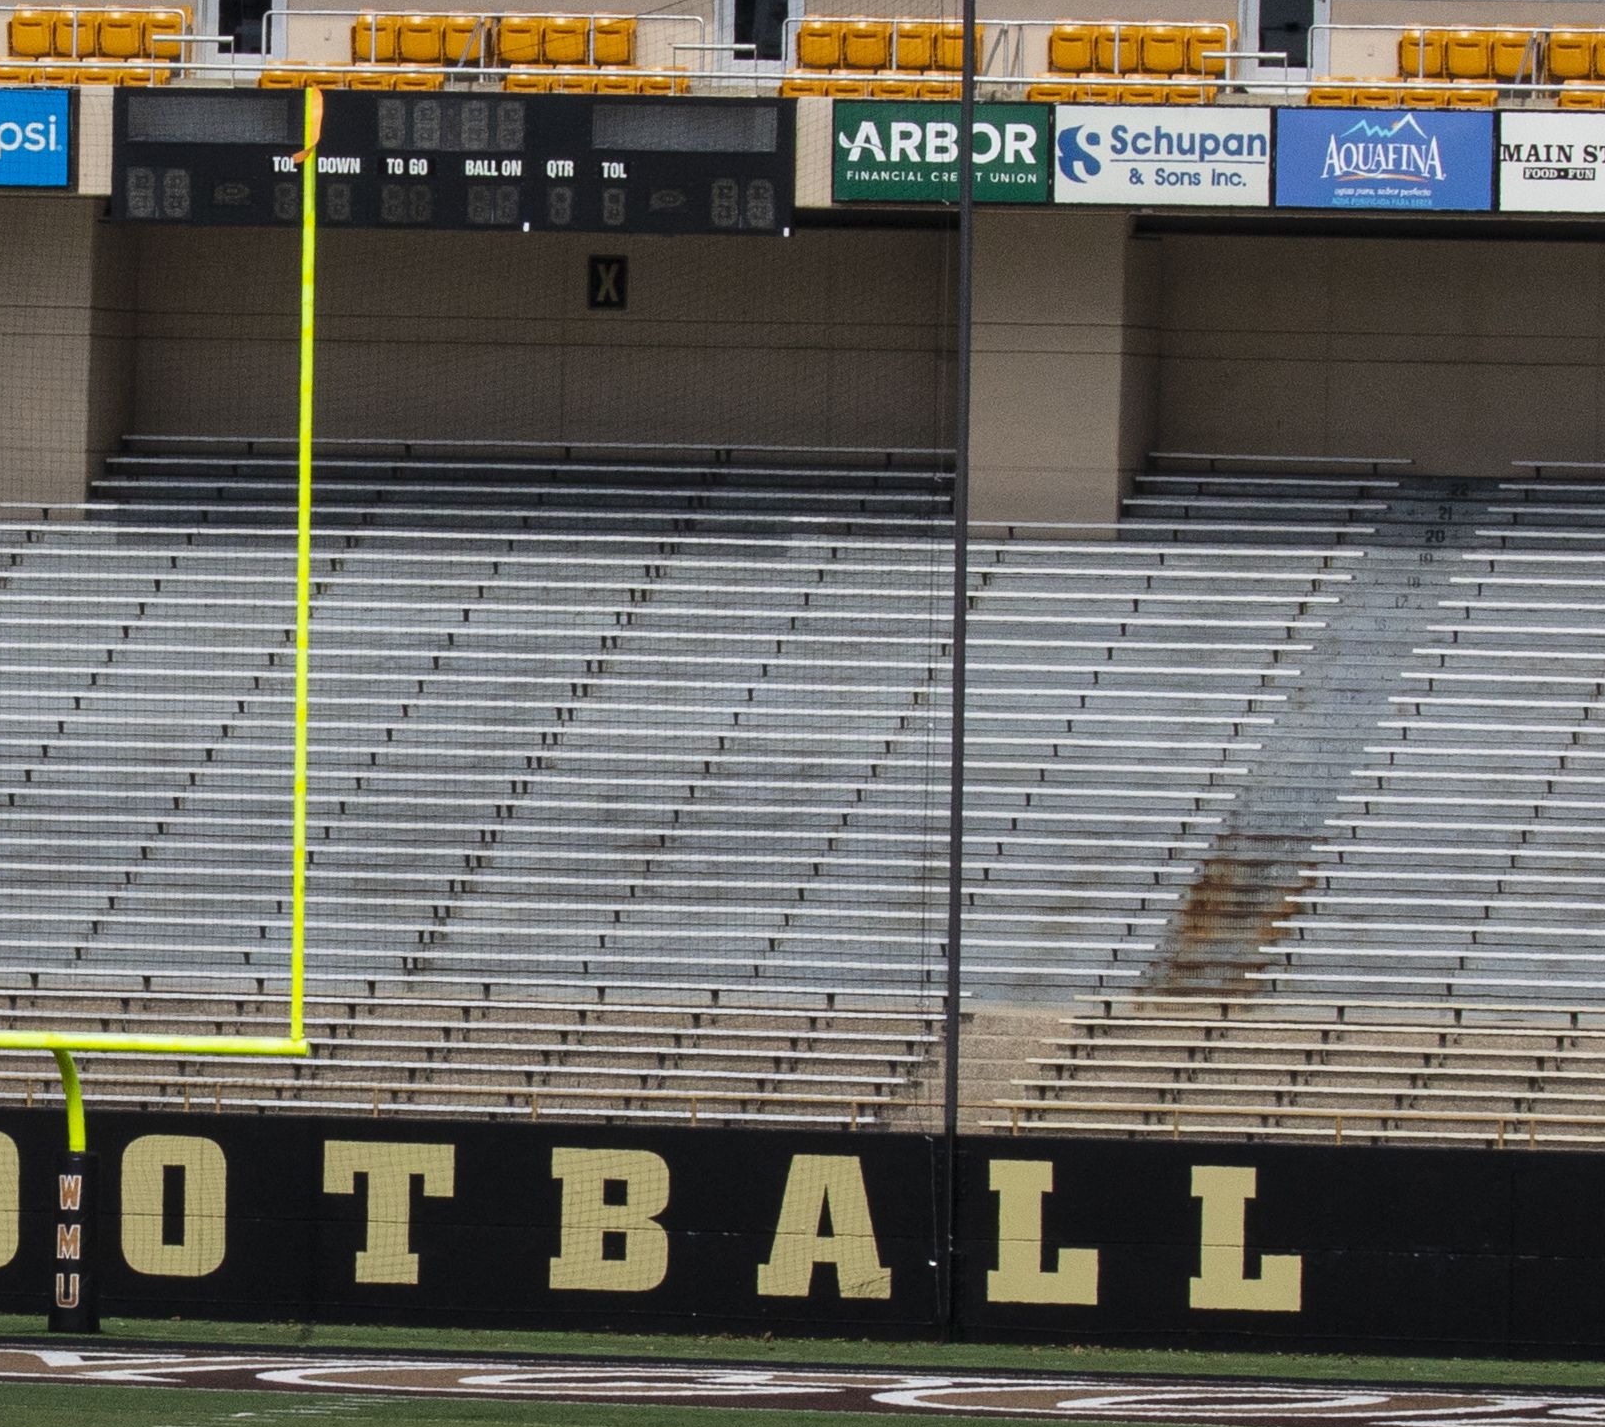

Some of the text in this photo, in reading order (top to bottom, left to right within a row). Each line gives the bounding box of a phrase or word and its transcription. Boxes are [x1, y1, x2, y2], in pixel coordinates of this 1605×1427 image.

[839, 121, 1037, 163] ARBOR
[1111, 125, 1267, 164] Schupan
[1321, 133, 1446, 180] AQUAFINA
[1501, 144, 1573, 164] MAIN
[273, 157, 297, 171] TOL
[319, 157, 360, 173] DOWN
[387, 159, 427, 175] TO GO
[466, 160, 521, 175] BALL ON
[547, 161, 573, 178] QTR
[602, 163, 627, 178] TOL
[847, 171, 1037, 183] FINANCIAL CRET UNION
[1129, 168, 1246, 187] & Sons Inc.
[1523, 168, 1595, 181] FOOD FUN
[596, 263, 620, 301] X
